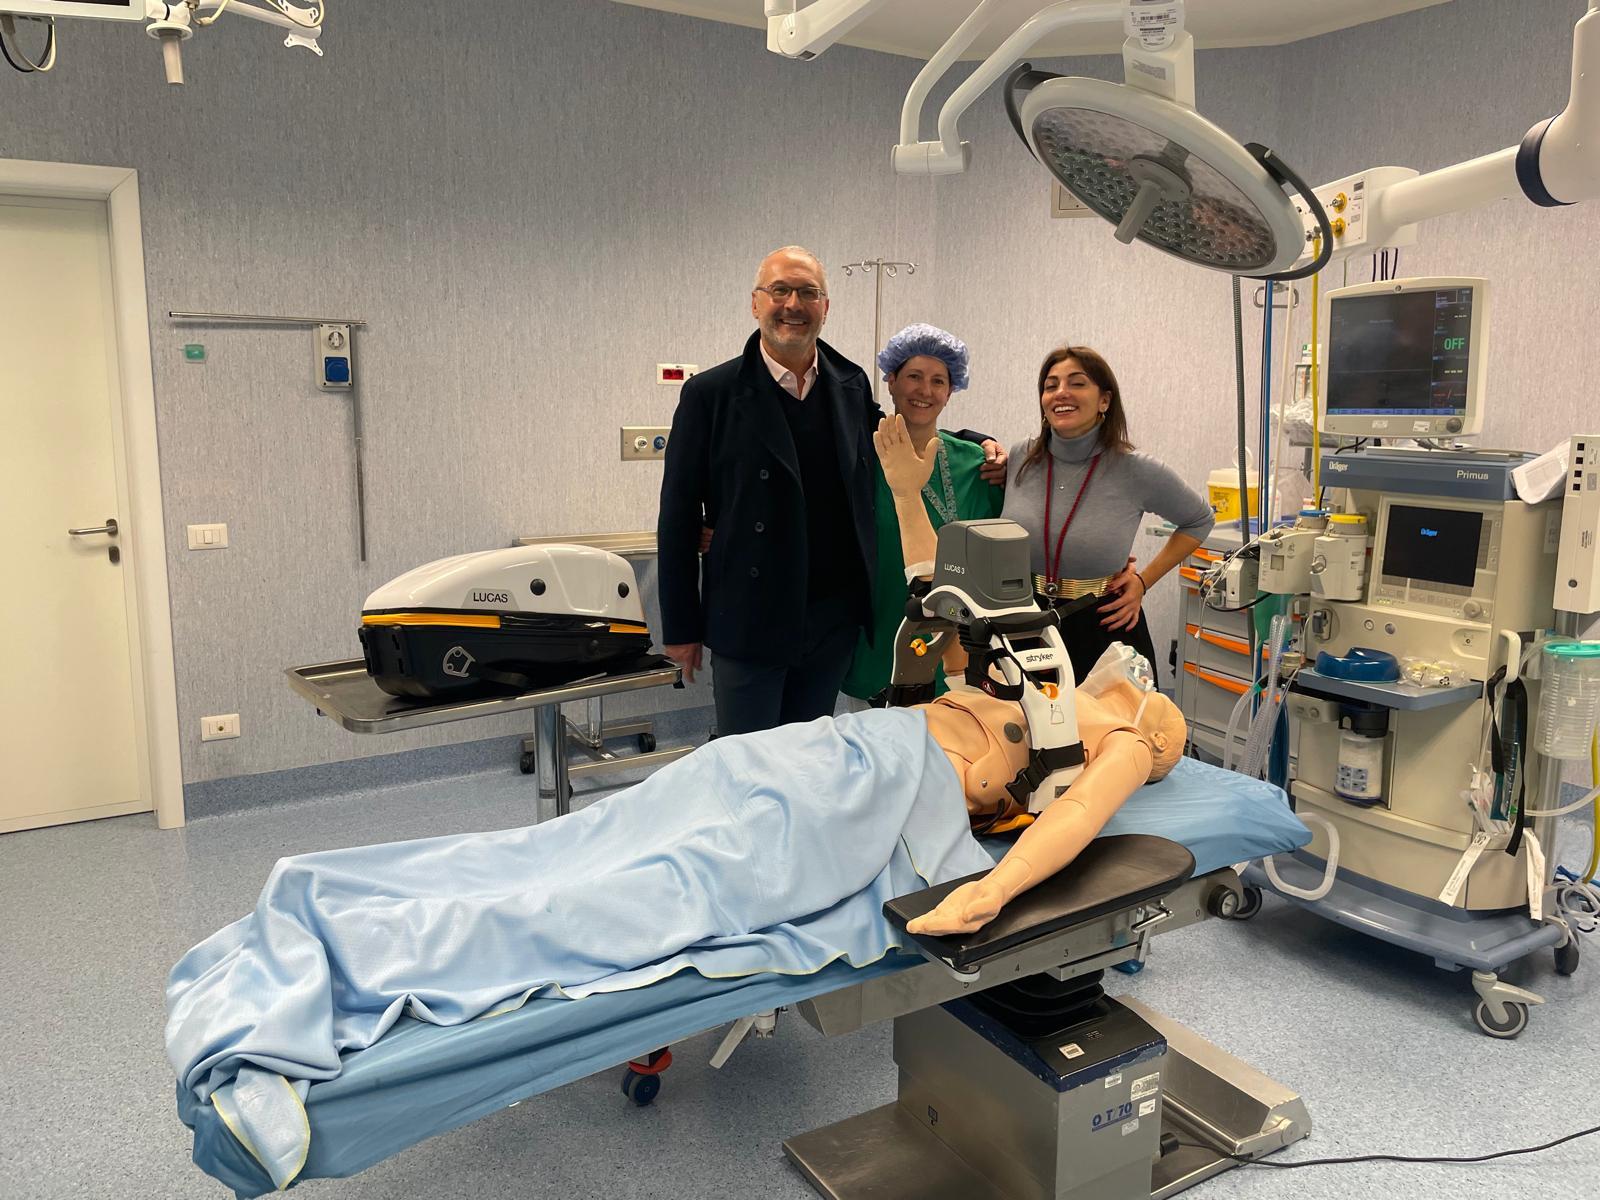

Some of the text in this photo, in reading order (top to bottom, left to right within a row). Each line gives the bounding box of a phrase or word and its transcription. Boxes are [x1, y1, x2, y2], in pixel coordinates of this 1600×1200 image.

[1443, 338, 1465, 350] OFF
[1456, 470, 1489, 480] Primus
[944, 562, 961, 574] LUCAS
[473, 592, 508, 603] LUCAS
[1025, 653, 1054, 662] stryker
[1119, 1102, 1132, 1117] 70
